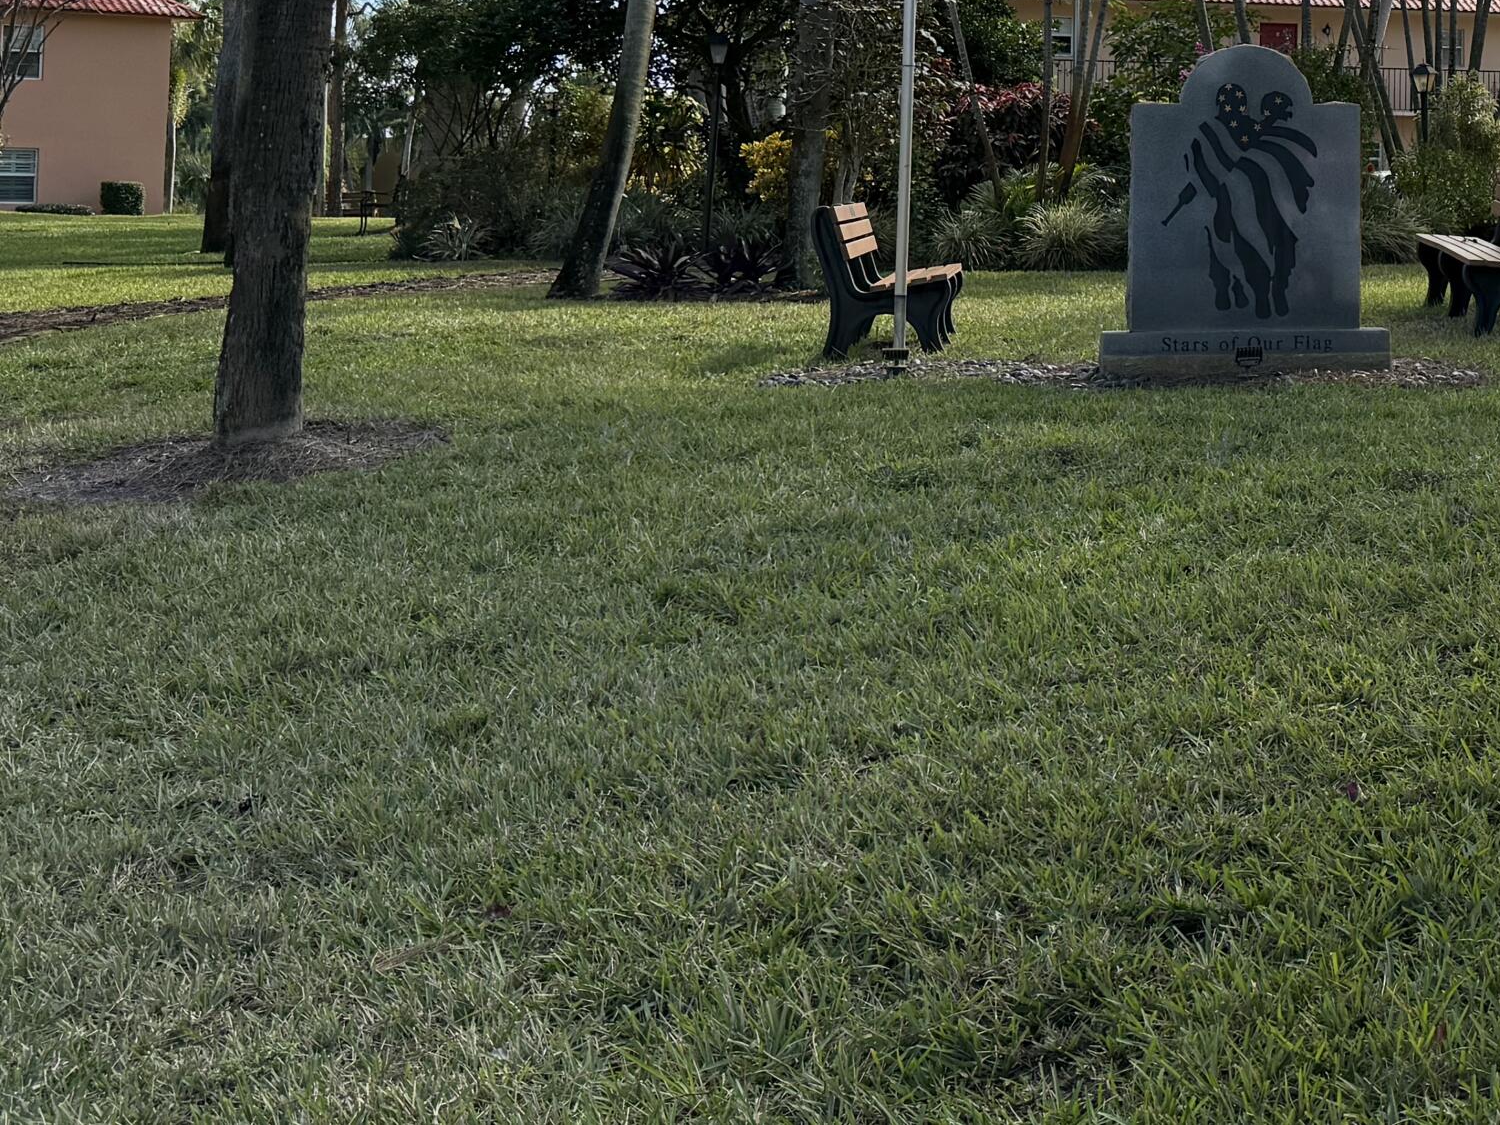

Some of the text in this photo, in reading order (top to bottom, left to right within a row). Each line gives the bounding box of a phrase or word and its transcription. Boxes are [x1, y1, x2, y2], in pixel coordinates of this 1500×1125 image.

[1161, 335, 1332, 353] Stars of Our Flag
